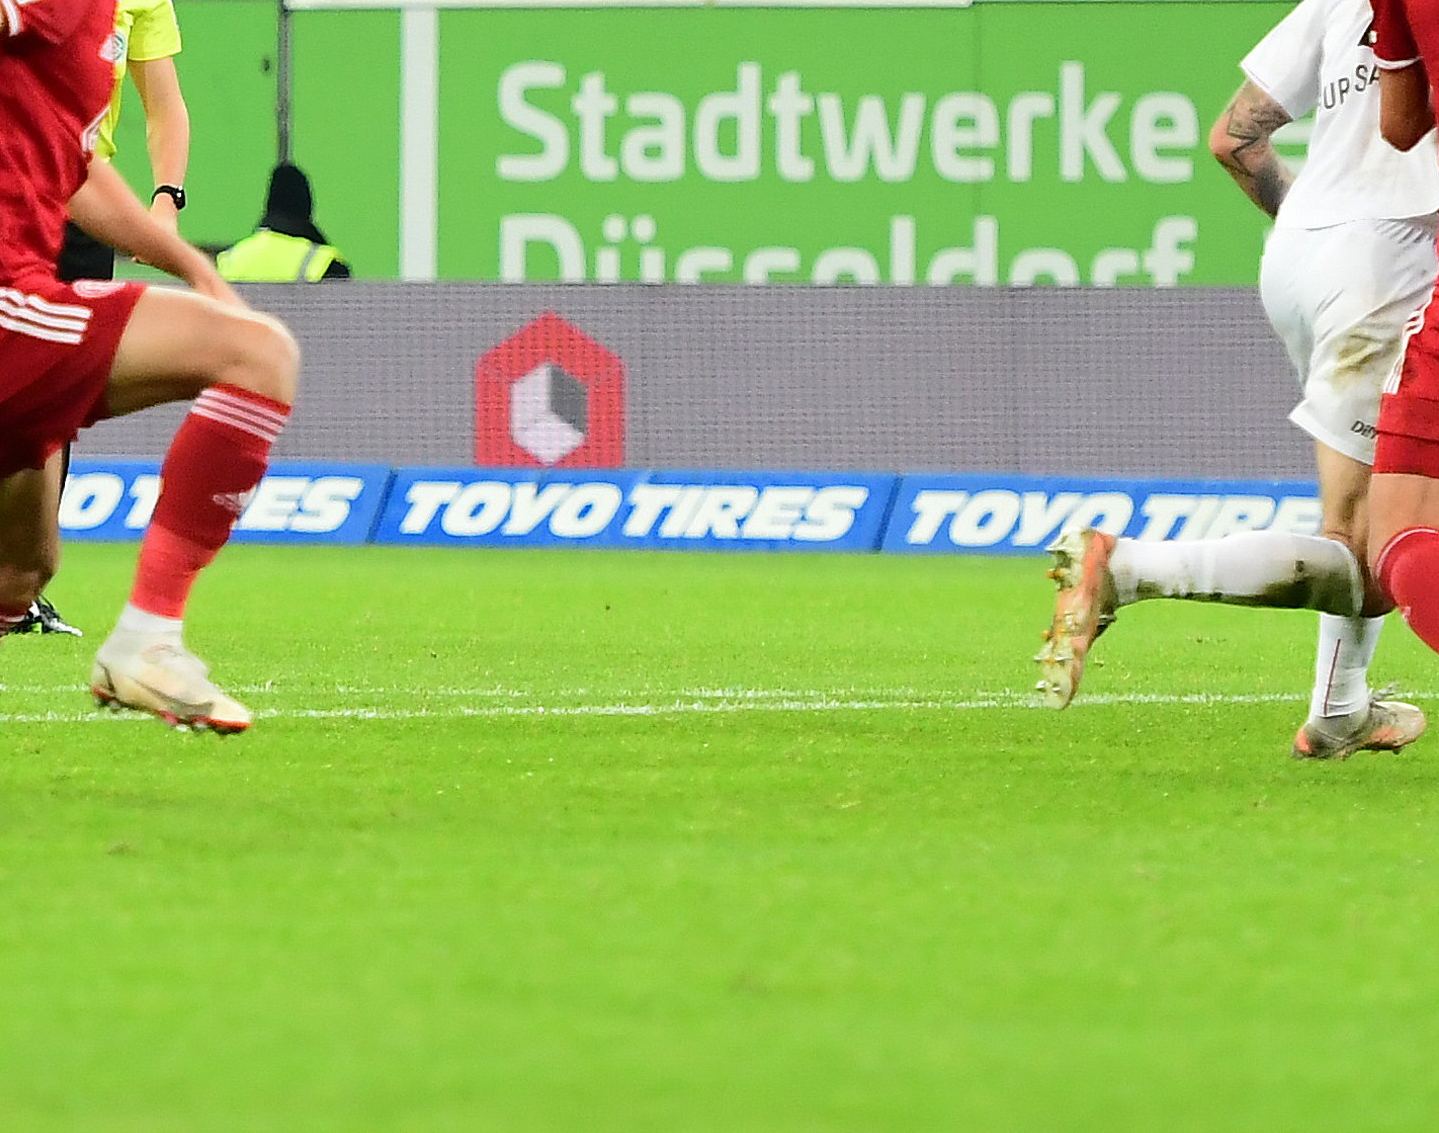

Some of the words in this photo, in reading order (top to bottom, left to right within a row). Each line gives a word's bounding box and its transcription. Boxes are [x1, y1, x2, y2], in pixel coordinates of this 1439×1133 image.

[495, 60, 1202, 183] Stadtwerke
[398, 481, 623, 539] TOYO
[621, 483, 868, 543] TIRES
[905, 488, 1135, 548] TOYO
